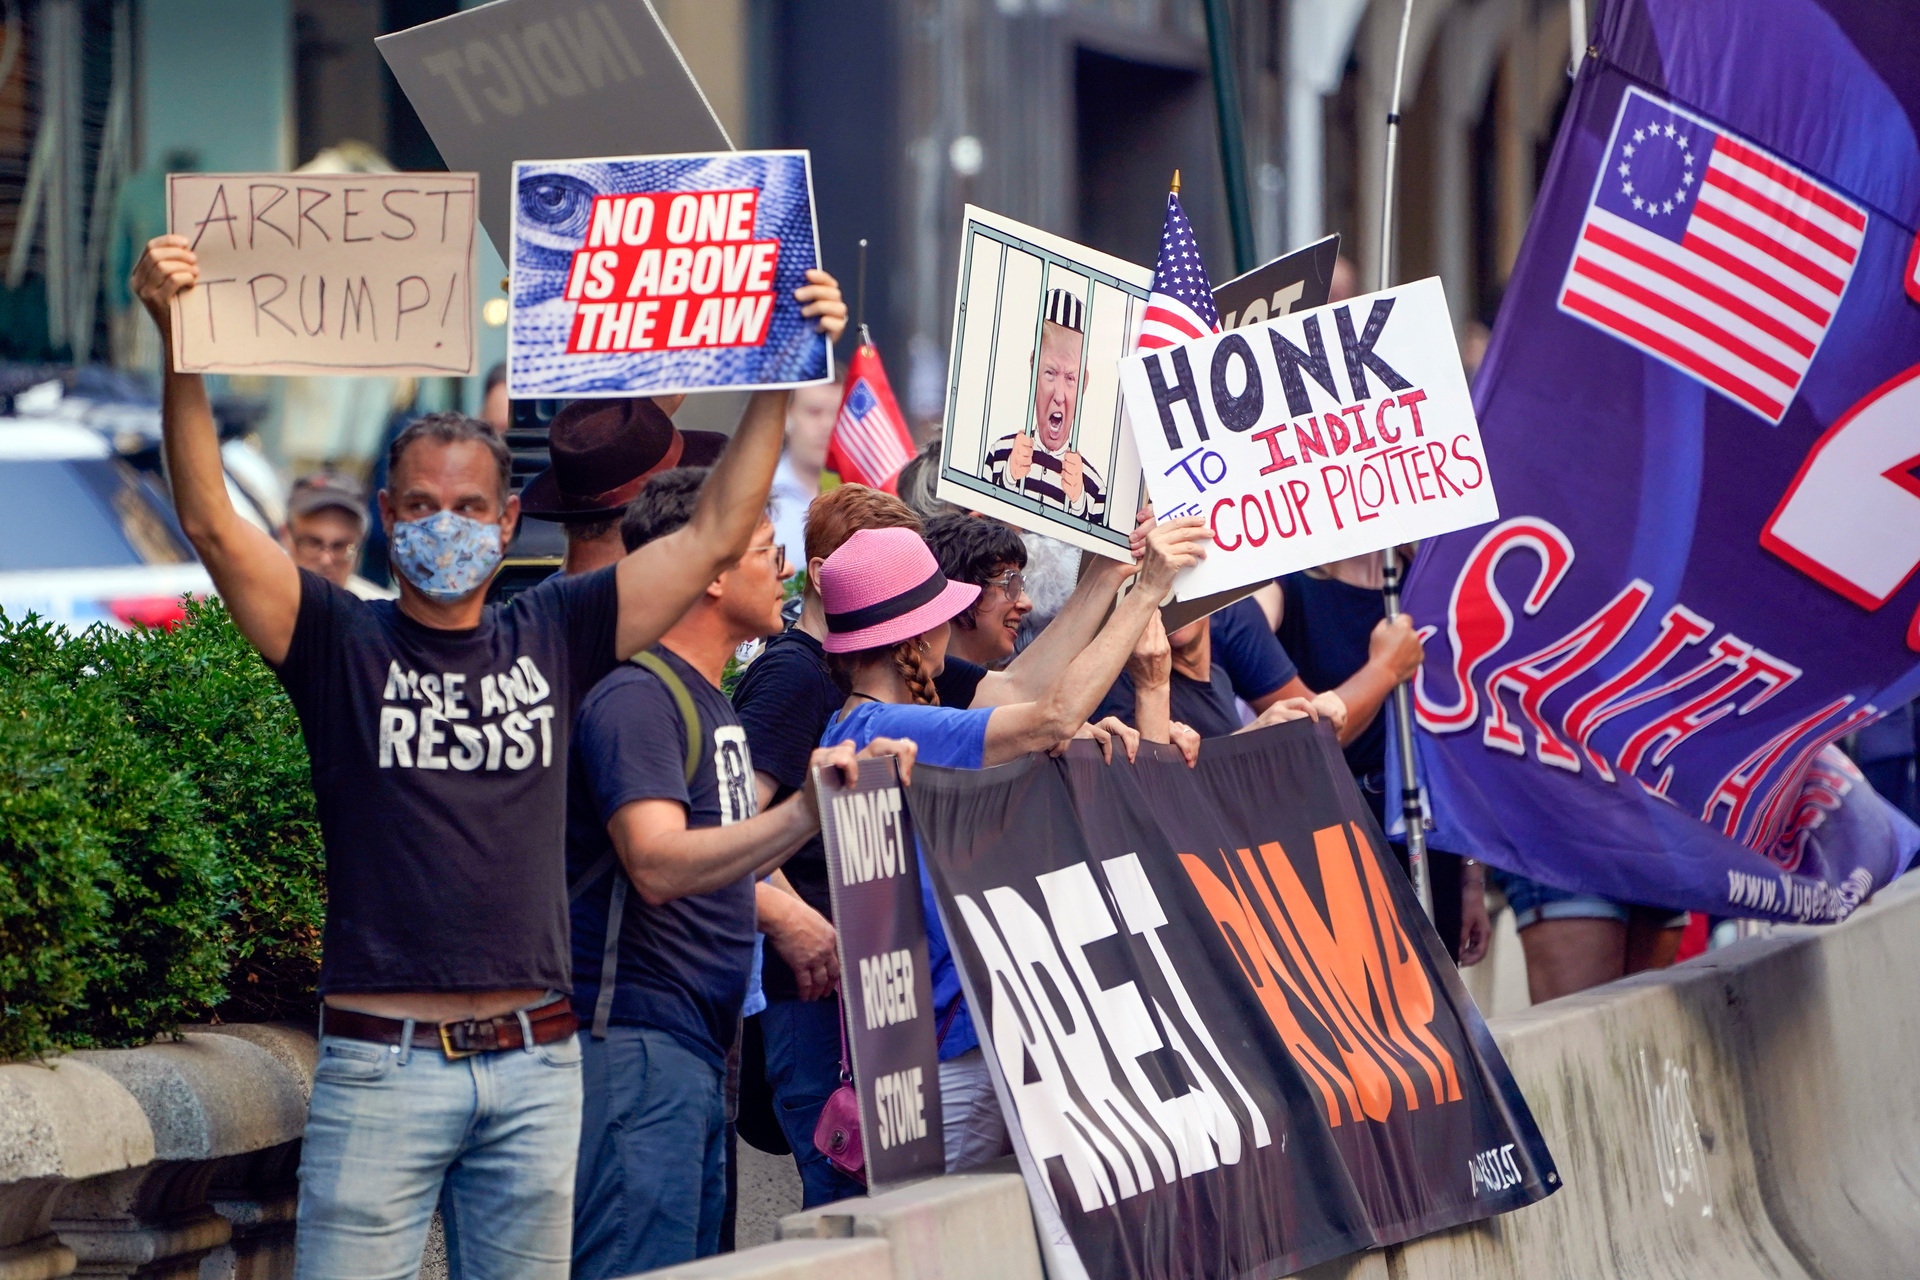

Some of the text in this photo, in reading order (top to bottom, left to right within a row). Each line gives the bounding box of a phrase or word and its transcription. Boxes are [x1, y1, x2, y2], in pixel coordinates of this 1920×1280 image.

[191, 184, 475, 251] ARREST
[588, 192, 754, 248] NO ONE
[194, 272, 458, 349] TRUMP!
[567, 243, 776, 300] IS ABOVE
[576, 295, 773, 351] THE LAW
[1142, 297, 1414, 451] HONK
[1164, 389, 1428, 493] TO INDICT
[1211, 480, 1313, 551] COUP
[1321, 434, 1483, 530] PLOTTERS
[480, 655, 551, 717] AND
[1413, 515, 1802, 804] SAVE
[379, 704, 556, 771] RESIST
[832, 787, 907, 887] INDICT
[859, 949, 919, 1031] ROGER
[874, 1066, 928, 1151] STONE
